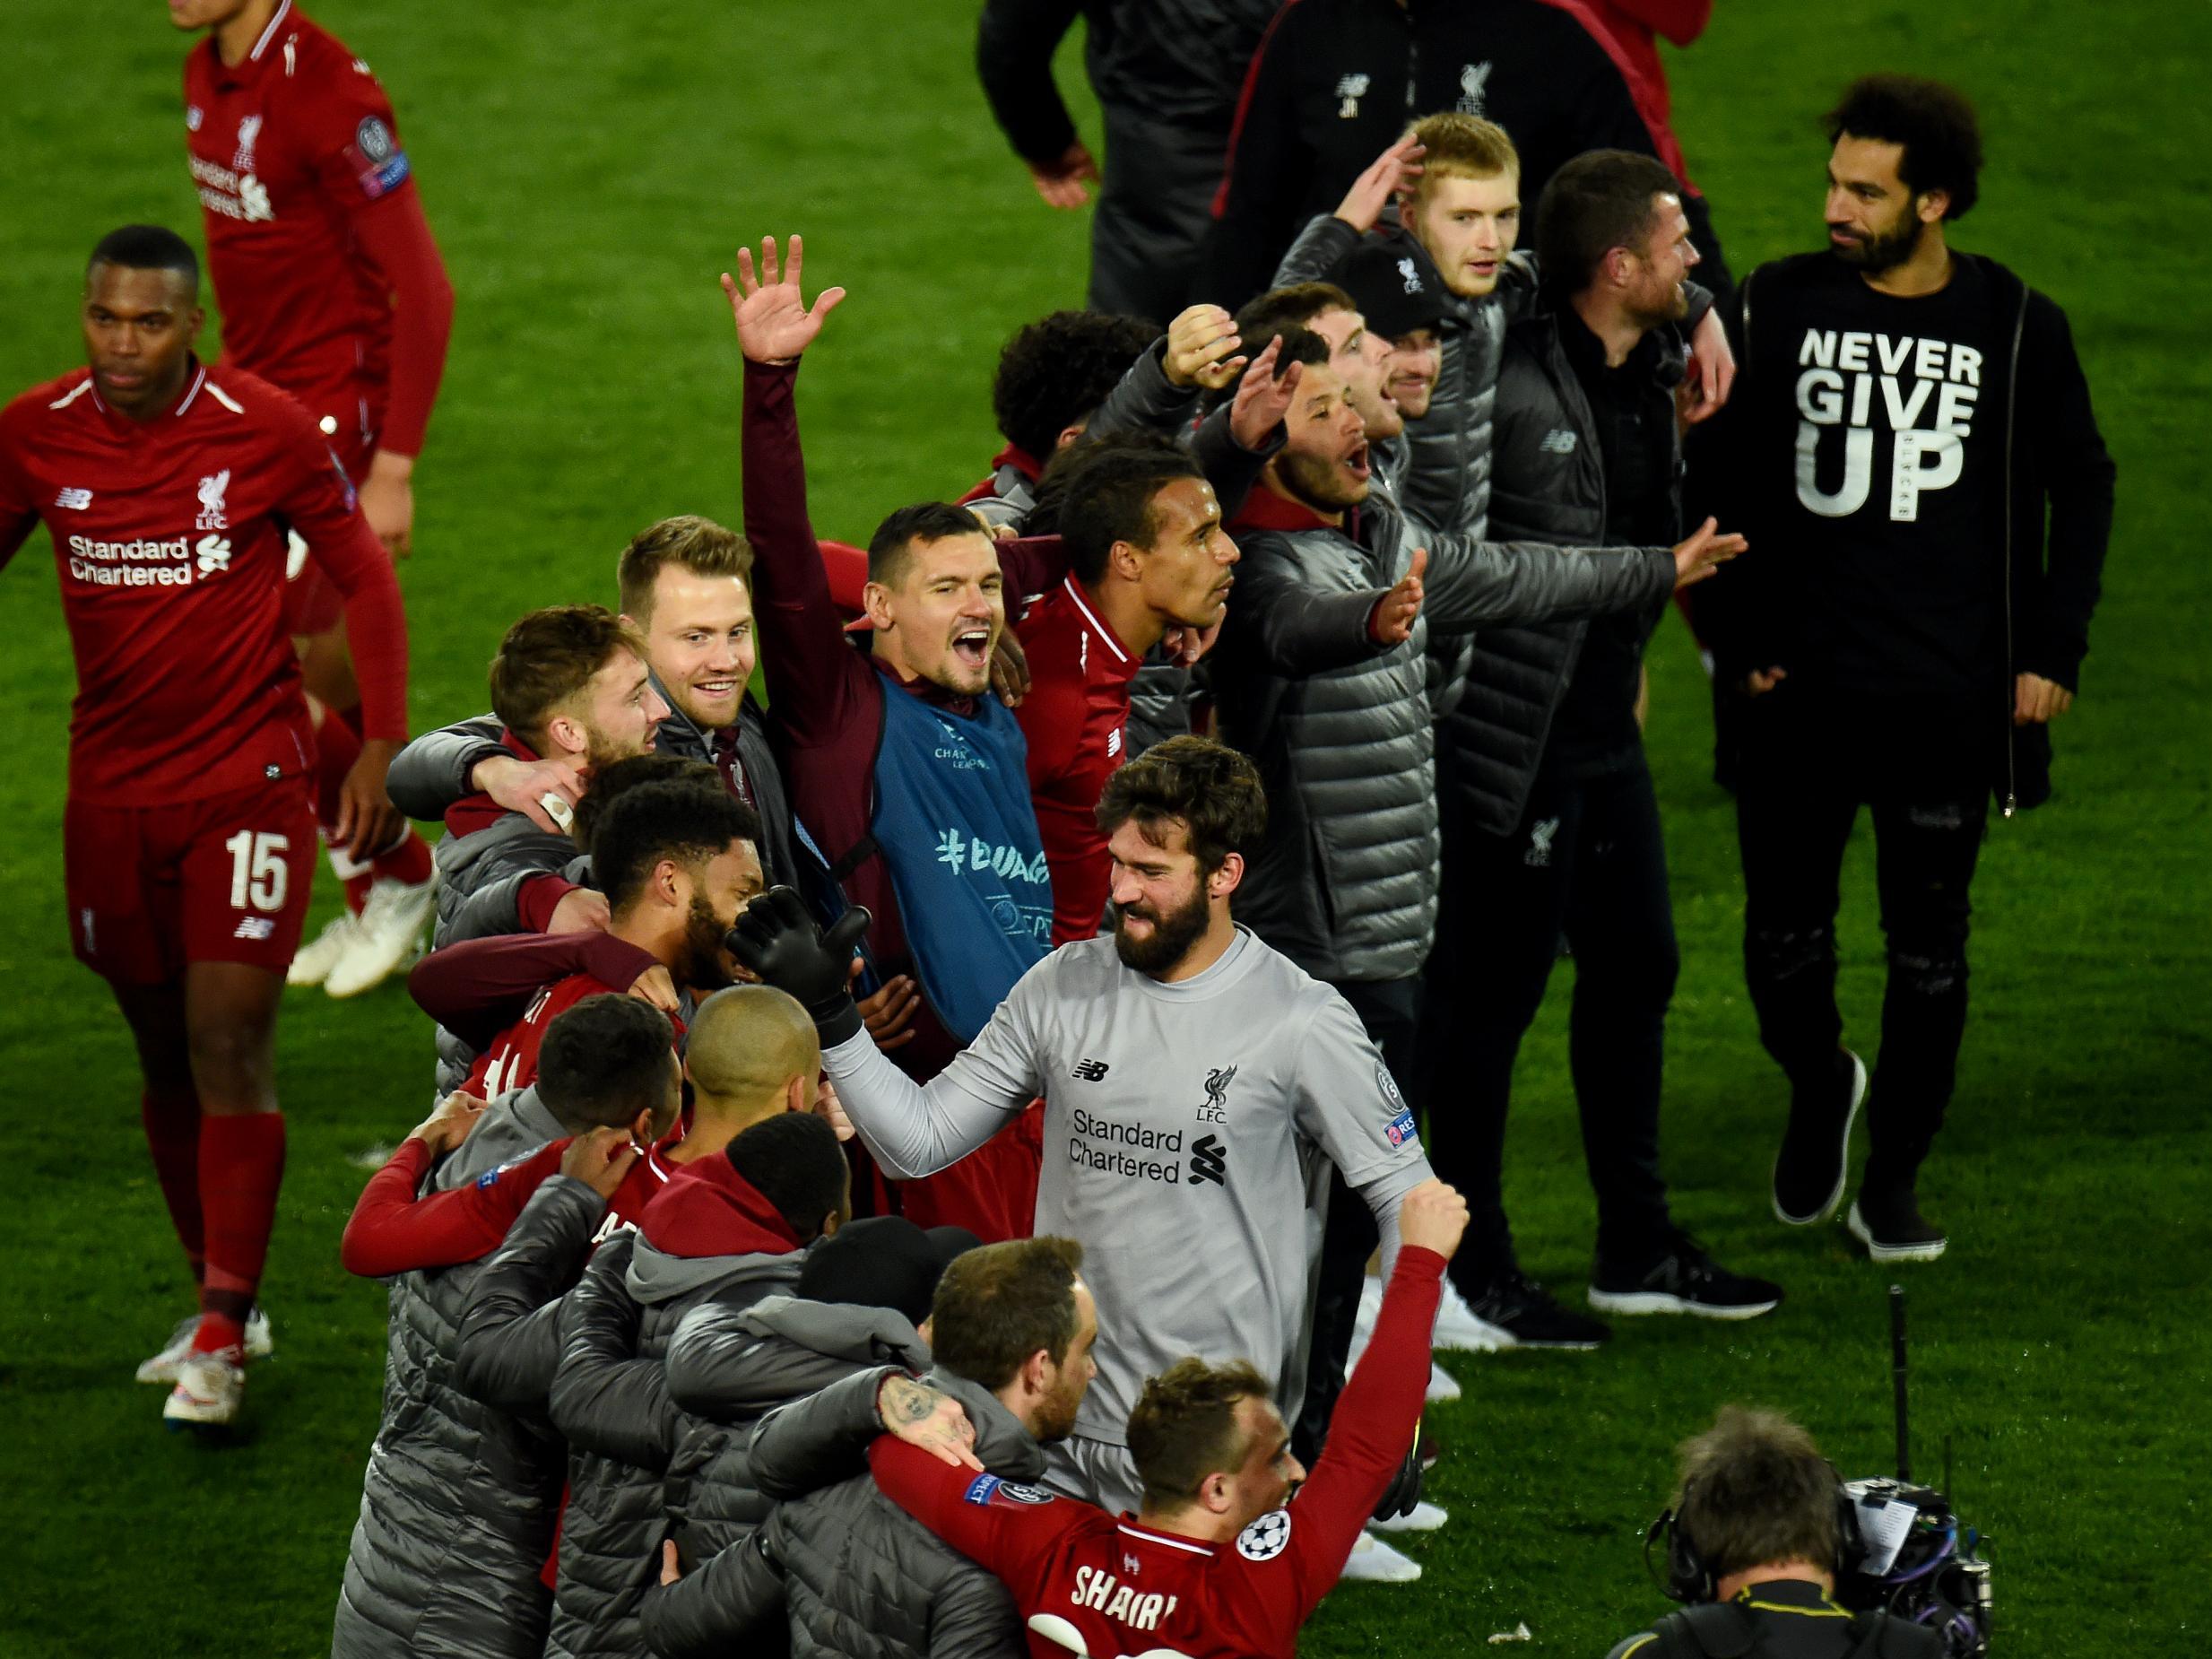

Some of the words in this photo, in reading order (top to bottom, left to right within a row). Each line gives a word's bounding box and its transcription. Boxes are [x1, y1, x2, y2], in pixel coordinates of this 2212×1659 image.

[1799, 328, 1982, 387] NEVER
[1796, 368, 1979, 438] GIVE
[1795, 420, 1964, 521] UP
[69, 535, 189, 560] Standard
[70, 557, 192, 586] Chartered
[226, 829, 289, 913] 15
[1074, 1108, 1183, 1153] Standard
[1070, 1137, 1180, 1184] Chartered
